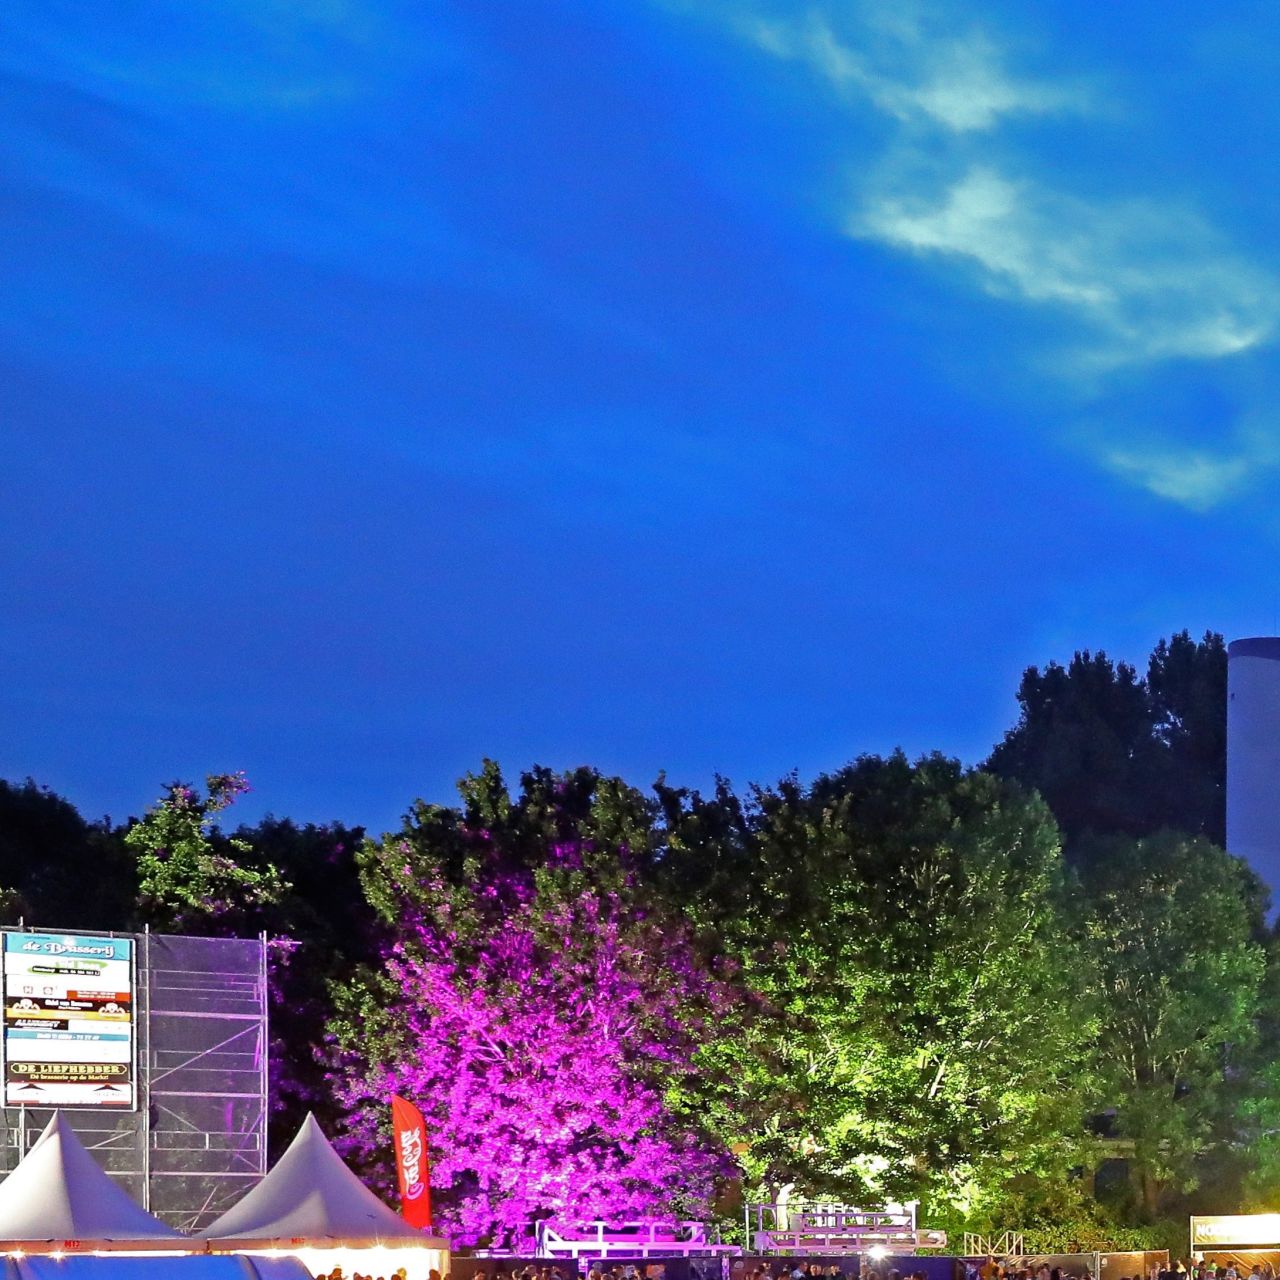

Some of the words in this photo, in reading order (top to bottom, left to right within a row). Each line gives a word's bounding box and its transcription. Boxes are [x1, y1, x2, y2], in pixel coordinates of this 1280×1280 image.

[44, 942, 115, 959] Brasserij
[18, 1064, 36, 1074] DE
[40, 1064, 120, 1075] LIEFHEBBER
